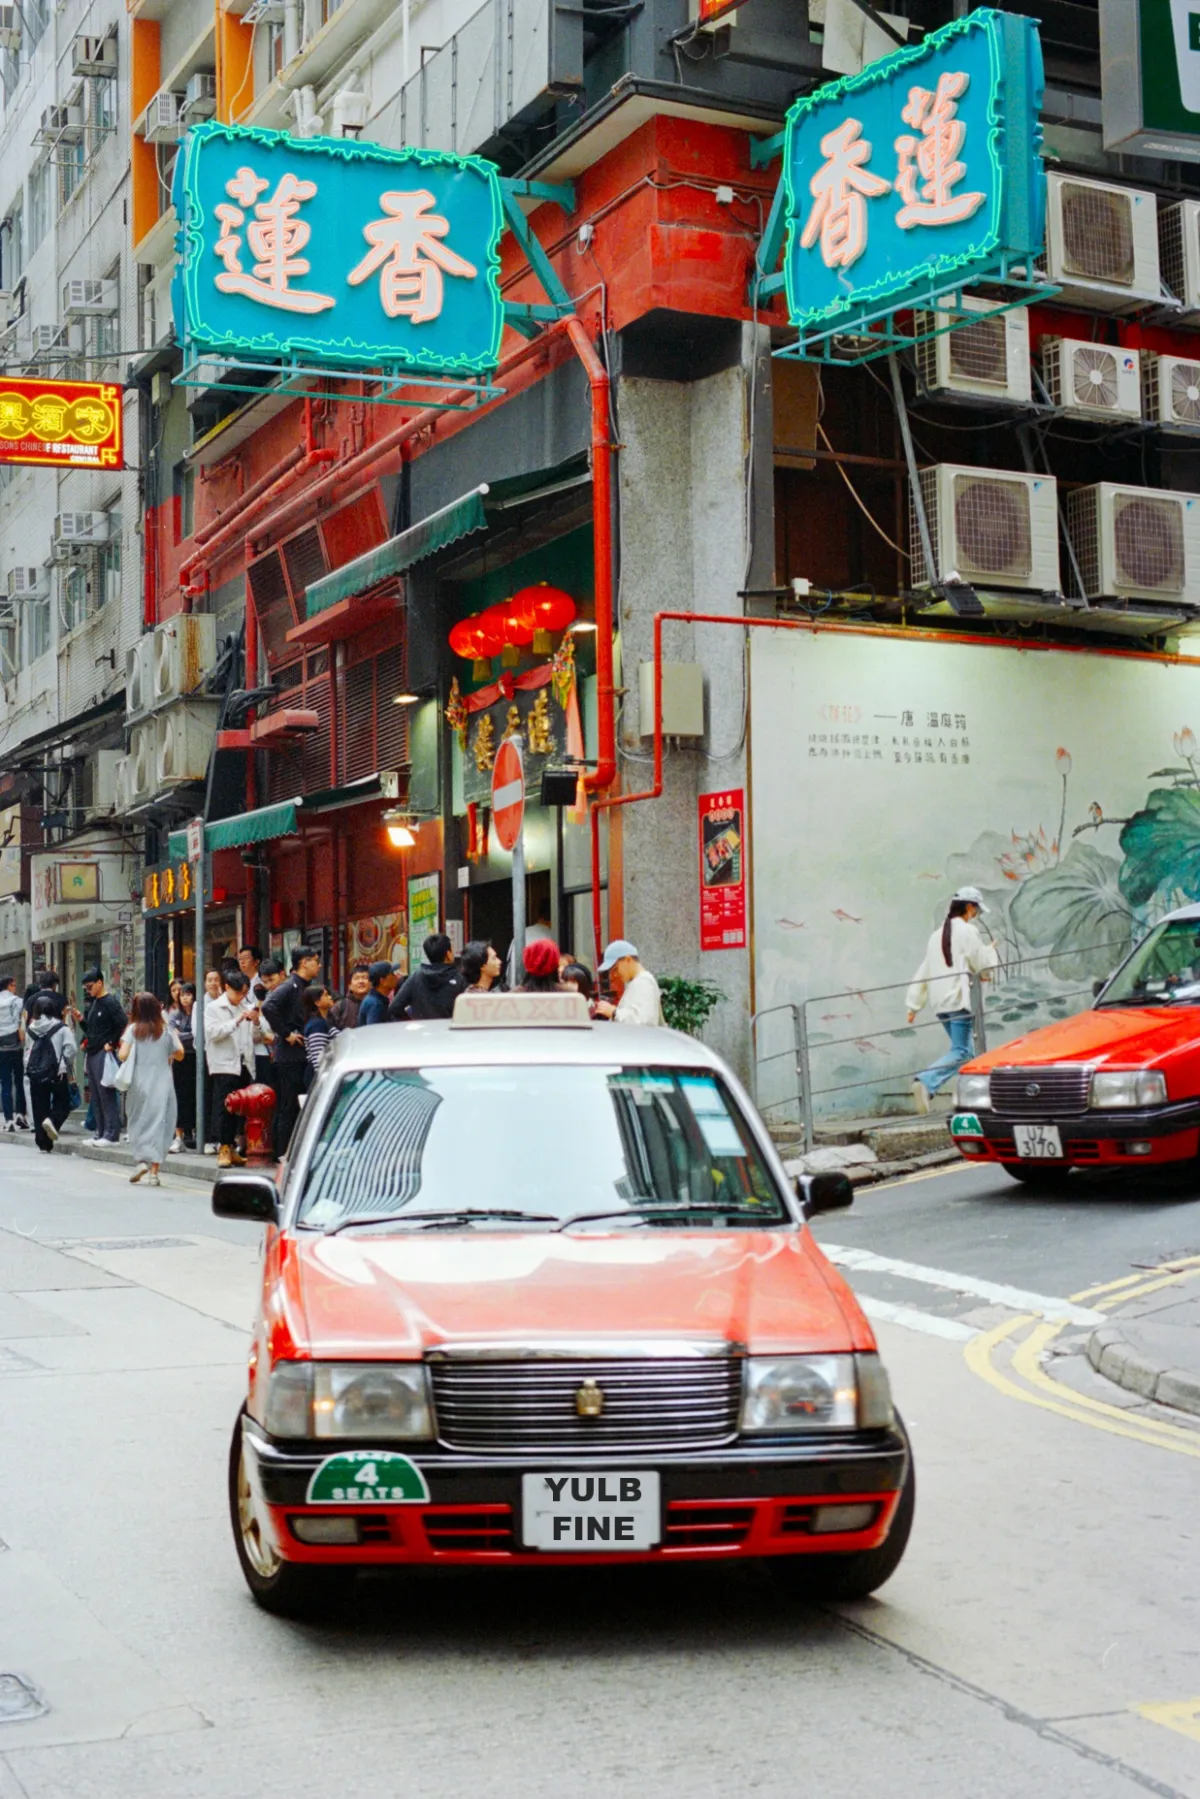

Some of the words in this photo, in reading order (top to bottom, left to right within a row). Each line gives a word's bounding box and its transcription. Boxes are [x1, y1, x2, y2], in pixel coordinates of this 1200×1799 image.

[214, 167, 477, 324] 蓮香
[466, 999, 578, 1020] TAXI
[1023, 1141, 1057, 1157] 3170
[354, 1462, 379, 1486] 4
[331, 1487, 405, 1500] SEATS
[544, 1477, 642, 1502] YULB
[553, 1516, 635, 1541] FINE
